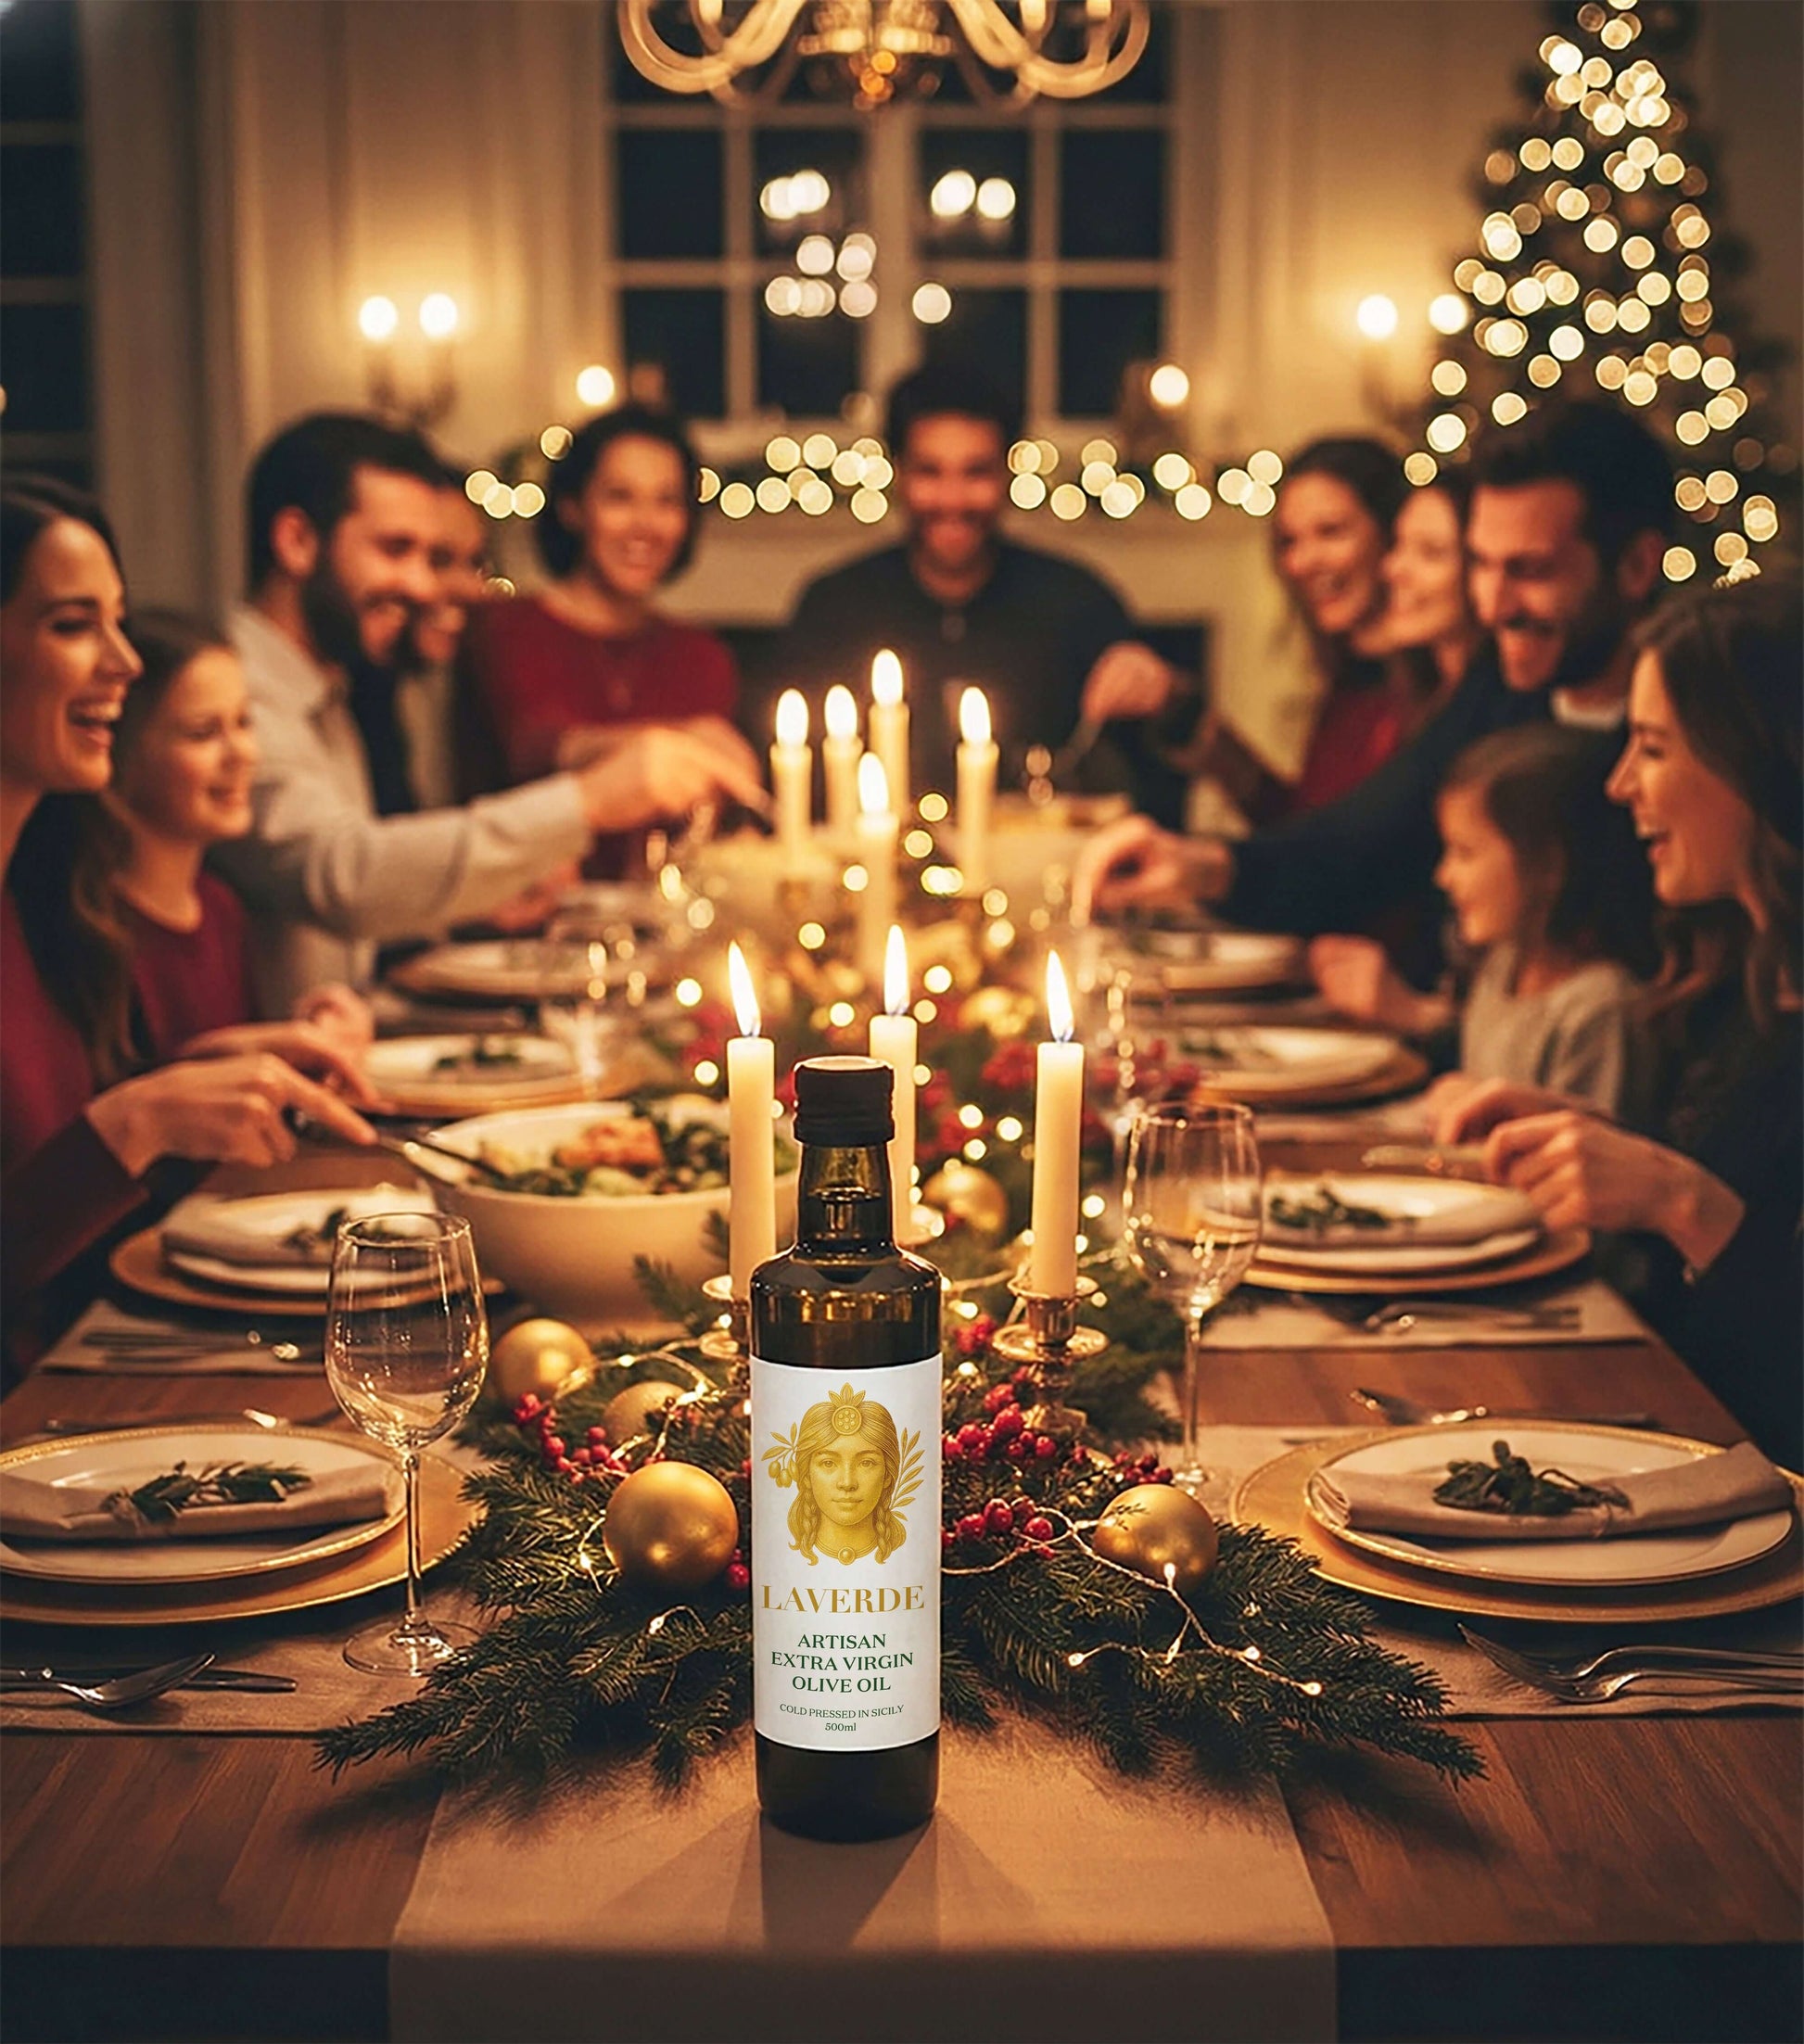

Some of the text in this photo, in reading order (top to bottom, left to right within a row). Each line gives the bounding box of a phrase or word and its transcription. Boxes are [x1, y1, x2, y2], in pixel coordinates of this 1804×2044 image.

[761, 1584, 924, 1614] LAVERDE
[797, 1633, 886, 1649] ARTISAN
[771, 1651, 913, 1670] EXTRA VIRGIN
[793, 1676, 891, 1693] OLIVE OIL
[780, 1704, 905, 1719] COLD PRESSED IN SICILY
[824, 1722, 857, 1732] 500ml
